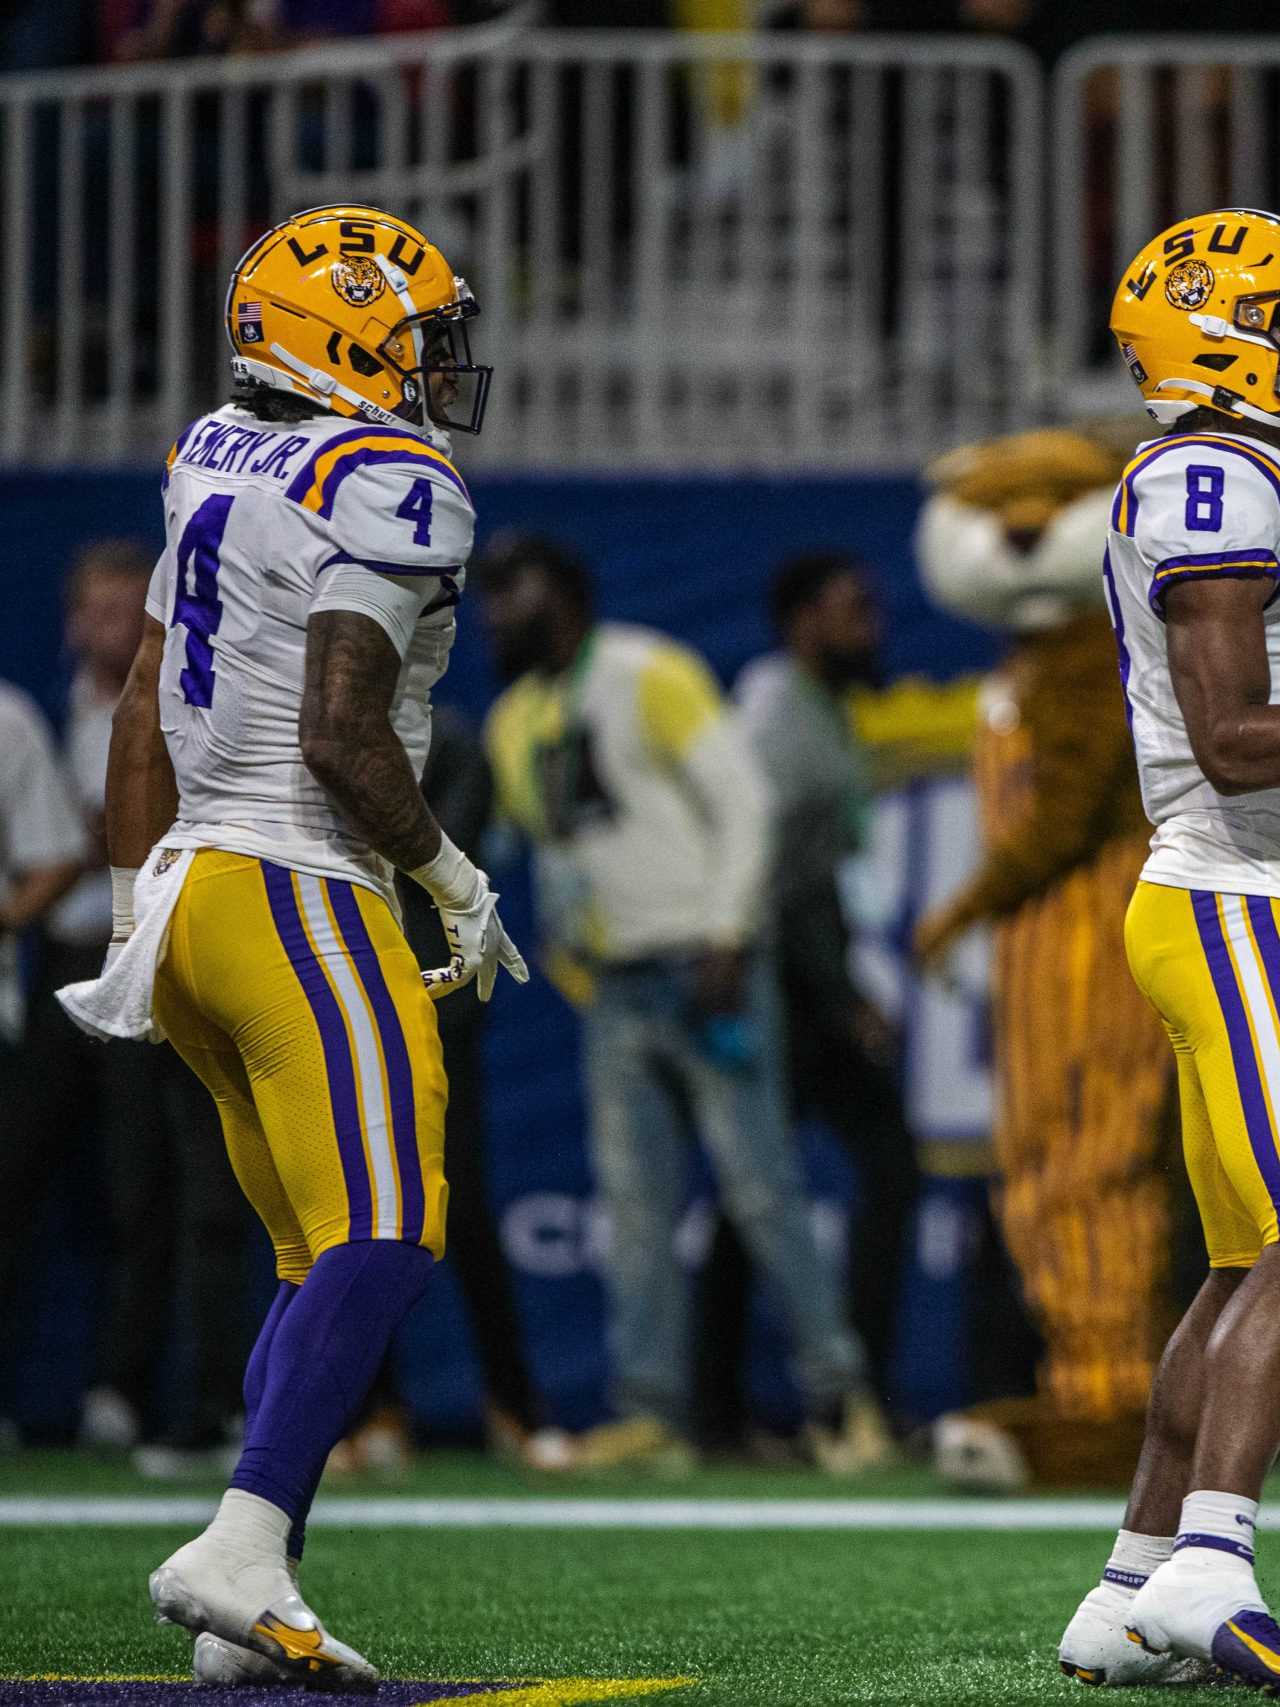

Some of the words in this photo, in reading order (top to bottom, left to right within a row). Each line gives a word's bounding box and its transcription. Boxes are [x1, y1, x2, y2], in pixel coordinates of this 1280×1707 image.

[287, 221, 426, 276] LSU
[1126, 223, 1249, 302] LSU
[183, 419, 278, 474] EMERY
[250, 435, 311, 480] JR.
[395, 478, 433, 547] 4
[1185, 464, 1225, 533] 8
[171, 494, 236, 709] 4
[1106, 1571, 1146, 1585] GRIP
